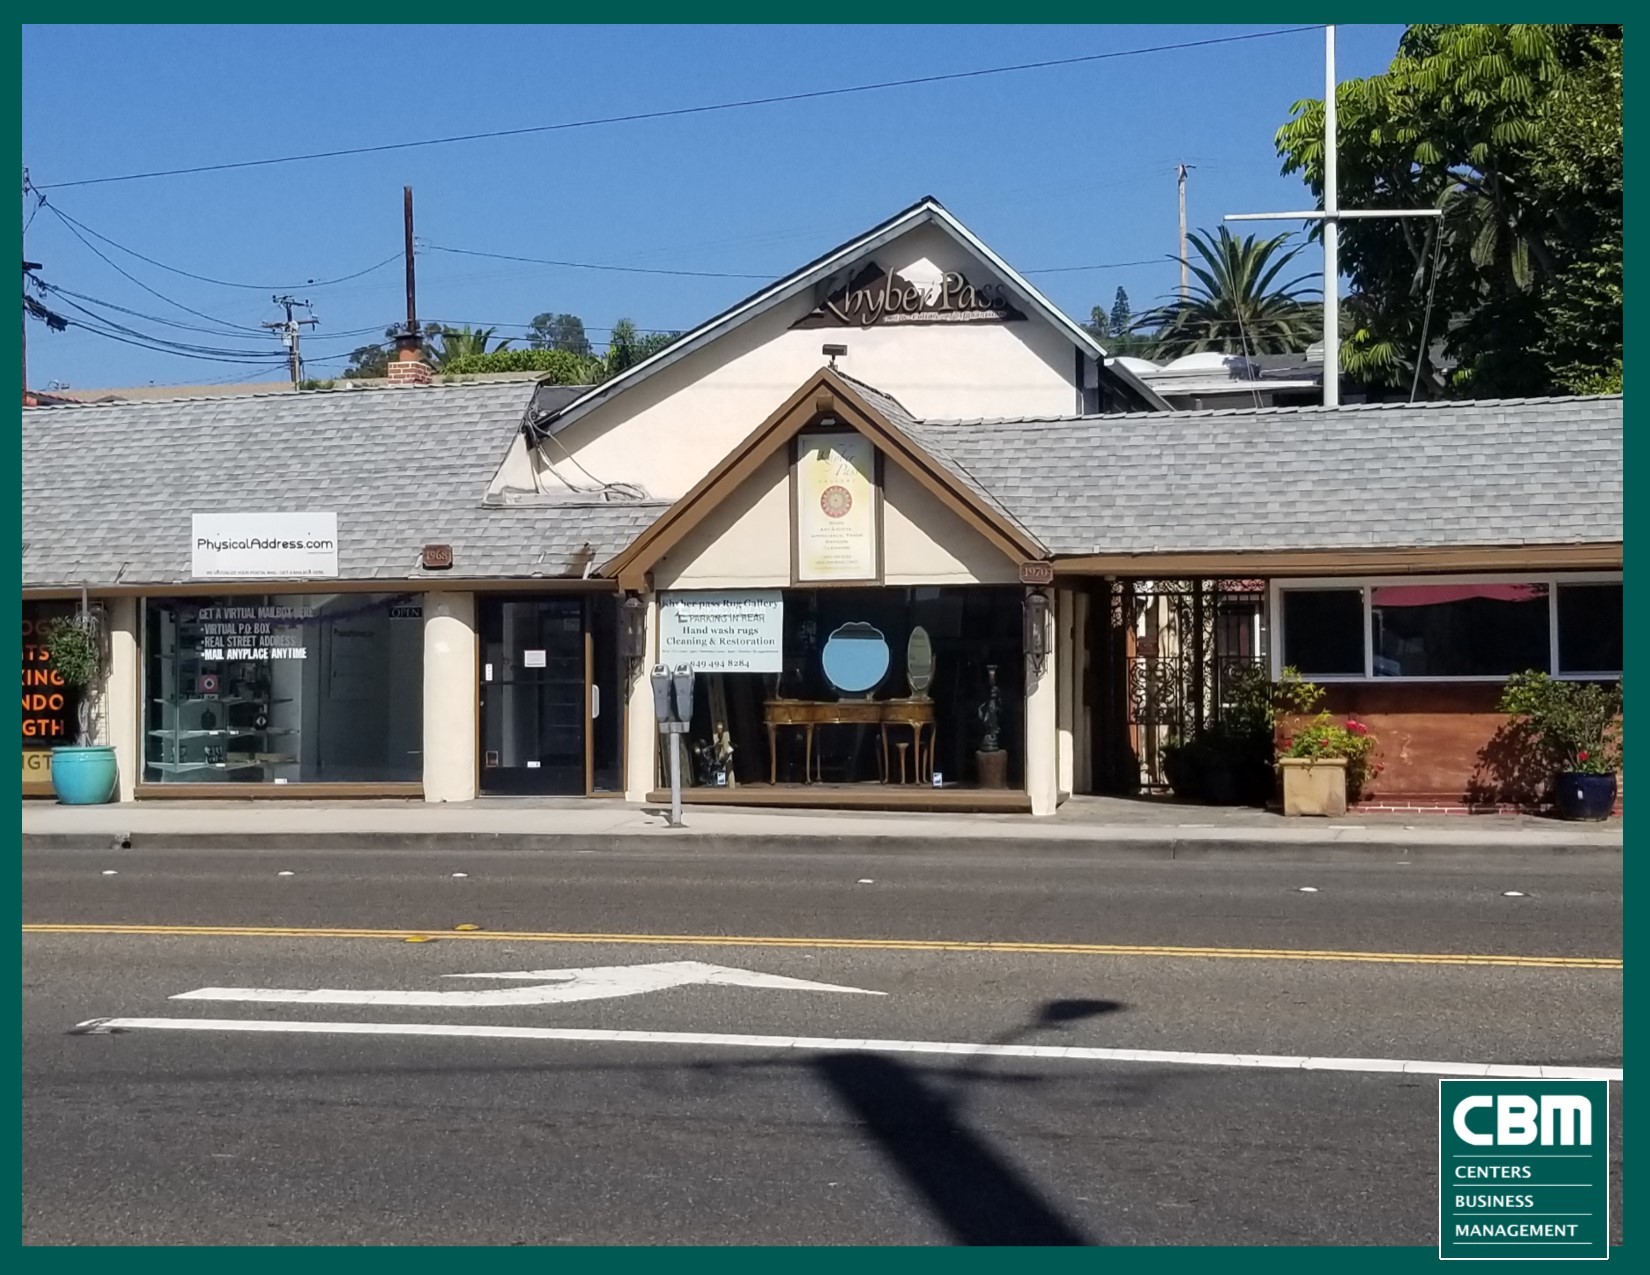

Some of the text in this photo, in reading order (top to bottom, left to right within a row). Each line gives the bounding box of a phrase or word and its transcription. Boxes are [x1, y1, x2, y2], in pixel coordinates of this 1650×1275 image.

[812, 267, 1006, 325] Khyber Pass
[197, 538, 333, 552] PhysicalAddress.com
[426, 550, 448, 560] 1968
[1024, 567, 1048, 577] 1970
[199, 608, 214, 619] GET
[215, 608, 221, 619] A
[224, 608, 255, 619] VIRTUAL
[258, 607, 292, 618] MAILBOX
[391, 607, 420, 617] OPEN
[689, 614, 728, 623] PARKING
[730, 613, 739, 622] IN
[204, 623, 237, 635] VIRTUAL
[254, 623, 271, 634] BOX
[682, 626, 759, 636] Hand wash rugs
[204, 635, 297, 647] REAL STREET ADDRESS
[666, 636, 775, 646] Cleaning & Restoration
[204, 647, 307, 660] MAIL ANYPLACE ANYTIME
[708, 660, 725, 669] 494
[727, 659, 750, 669] 8284
